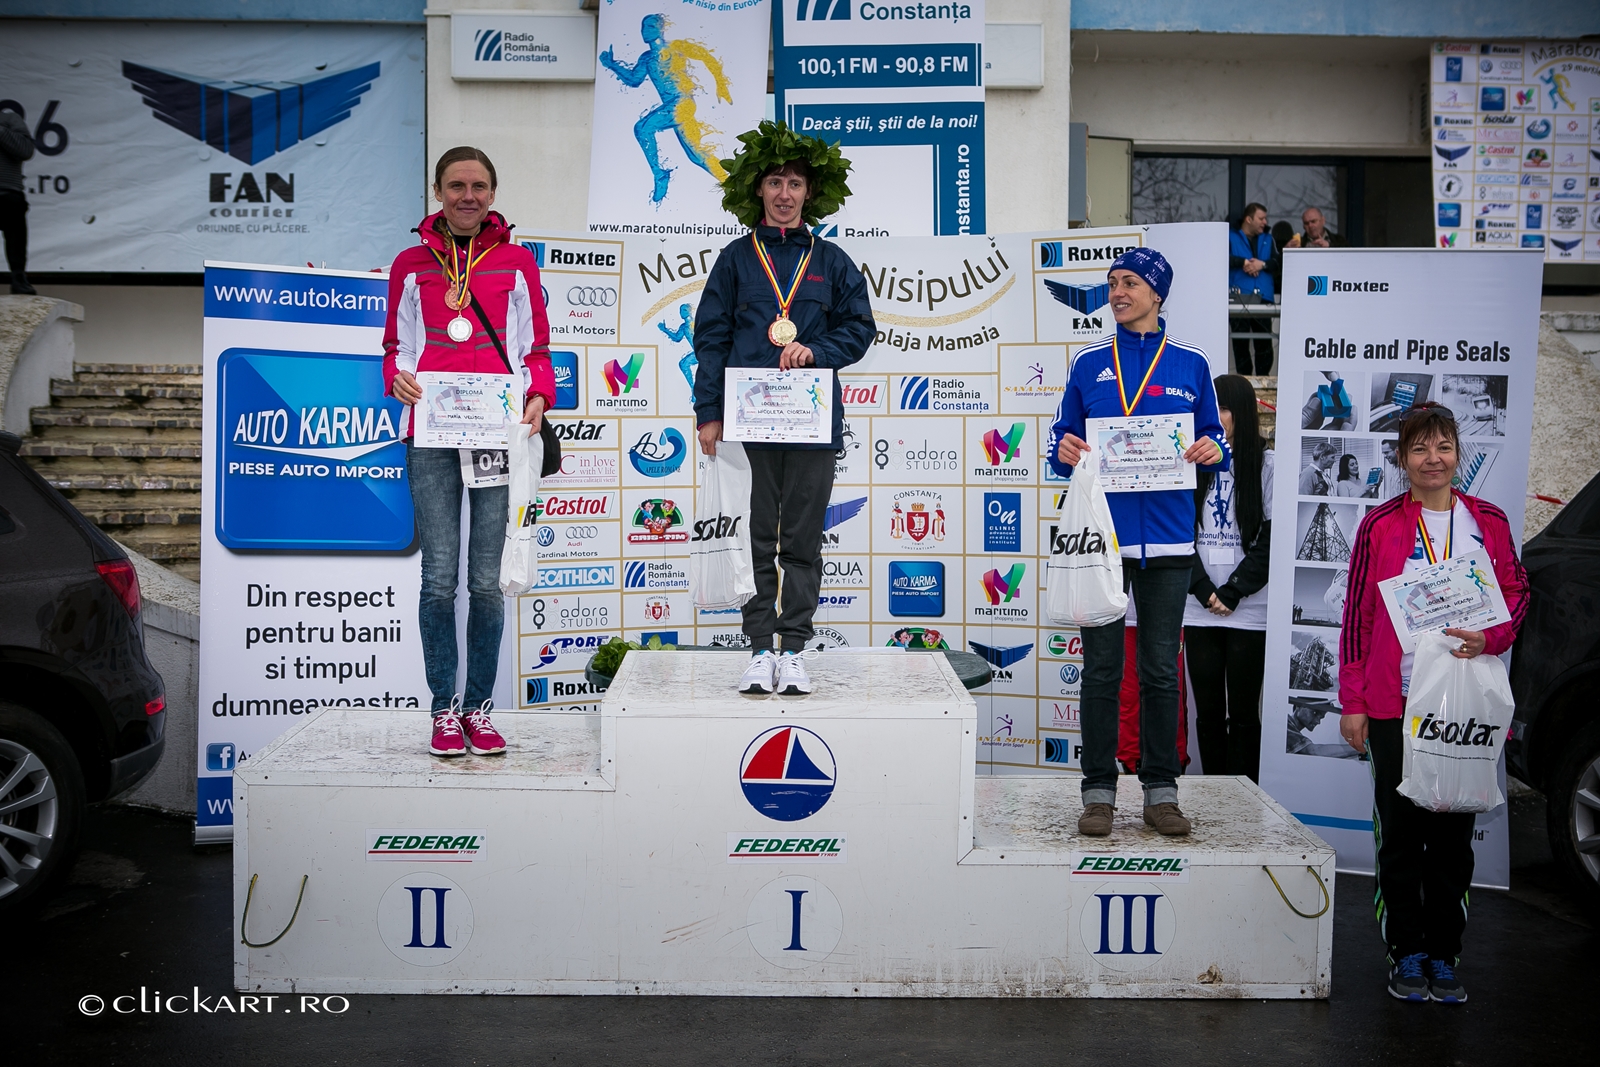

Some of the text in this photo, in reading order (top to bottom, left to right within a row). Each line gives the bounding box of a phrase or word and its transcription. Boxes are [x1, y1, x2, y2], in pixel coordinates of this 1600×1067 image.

[718, 2, 731, 11] din
[733, 0, 763, 10] Europ
[504, 32, 534, 42] Radio
[504, 42, 550, 52] România
[798, 57, 846, 77] 100,1
[850, 58, 878, 74] FM
[895, 57, 935, 75] 90,8
[940, 56, 968, 73] FM
[802, 117, 841, 131] Dacă
[906, 116, 926, 129] de
[930, 115, 944, 129] la
[948, 114, 978, 128] noi!
[209, 173, 295, 203] FAN
[209, 205, 295, 218] courier
[196, 223, 244, 235] ORIUNDE,
[247, 224, 261, 233] CU
[551, 249, 616, 267] Roxtec
[860, 241, 1010, 311] Nisipului
[1332, 280, 1389, 293] Roxtec
[214, 285, 387, 312] www.autokarm
[568, 310, 593, 318] Audi
[1072, 317, 1103, 330] FAN
[573, 326, 616, 335] Motors
[873, 325, 1001, 353] plaja Mamaia
[1304, 337, 1511, 366] Cable and Pipe Seals
[554, 366, 571, 377] RMA
[932, 379, 965, 389] Radio
[1096, 375, 1117, 383] adidas
[842, 385, 878, 404] trol
[932, 389, 981, 400] România
[596, 399, 648, 408] maritimo
[233, 406, 396, 445] AUTO KARMA
[551, 420, 605, 440] ostar
[906, 439, 957, 460] adora
[479, 451, 509, 471] 04
[580, 456, 590, 467] in
[593, 455, 615, 467] love
[906, 461, 957, 471] STUDIO
[229, 462, 403, 479] PIESE AUTO IMPORT
[580, 467, 616, 475] with life
[645, 465, 660, 473] APELE
[975, 468, 1028, 477] maritimo
[545, 496, 608, 516] Castrol
[1199, 532, 1219, 540] atonul
[648, 562, 673, 570] Radio
[537, 568, 613, 588] ECATHLON
[648, 571, 685, 579] România
[893, 575, 937, 587] AUTO KARMA
[247, 584, 395, 613] Din respect
[560, 597, 608, 619] adora
[975, 607, 1028, 617] maritimo
[560, 616, 608, 628] STUDIO
[246, 619, 401, 649] pentru banii
[265, 655, 376, 684] si timpul
[553, 681, 606, 696] Roxte
[1060, 688, 1080, 696] Cardi
[1005, 737, 1044, 746] SPORT
[373, 836, 480, 850] FEDERAL
[734, 838, 841, 852] FEDERAL
[1077, 857, 1184, 872] FEDERAL
[403, 886, 452, 949] II
[783, 889, 809, 951] I
[1093, 894, 1164, 954] III
